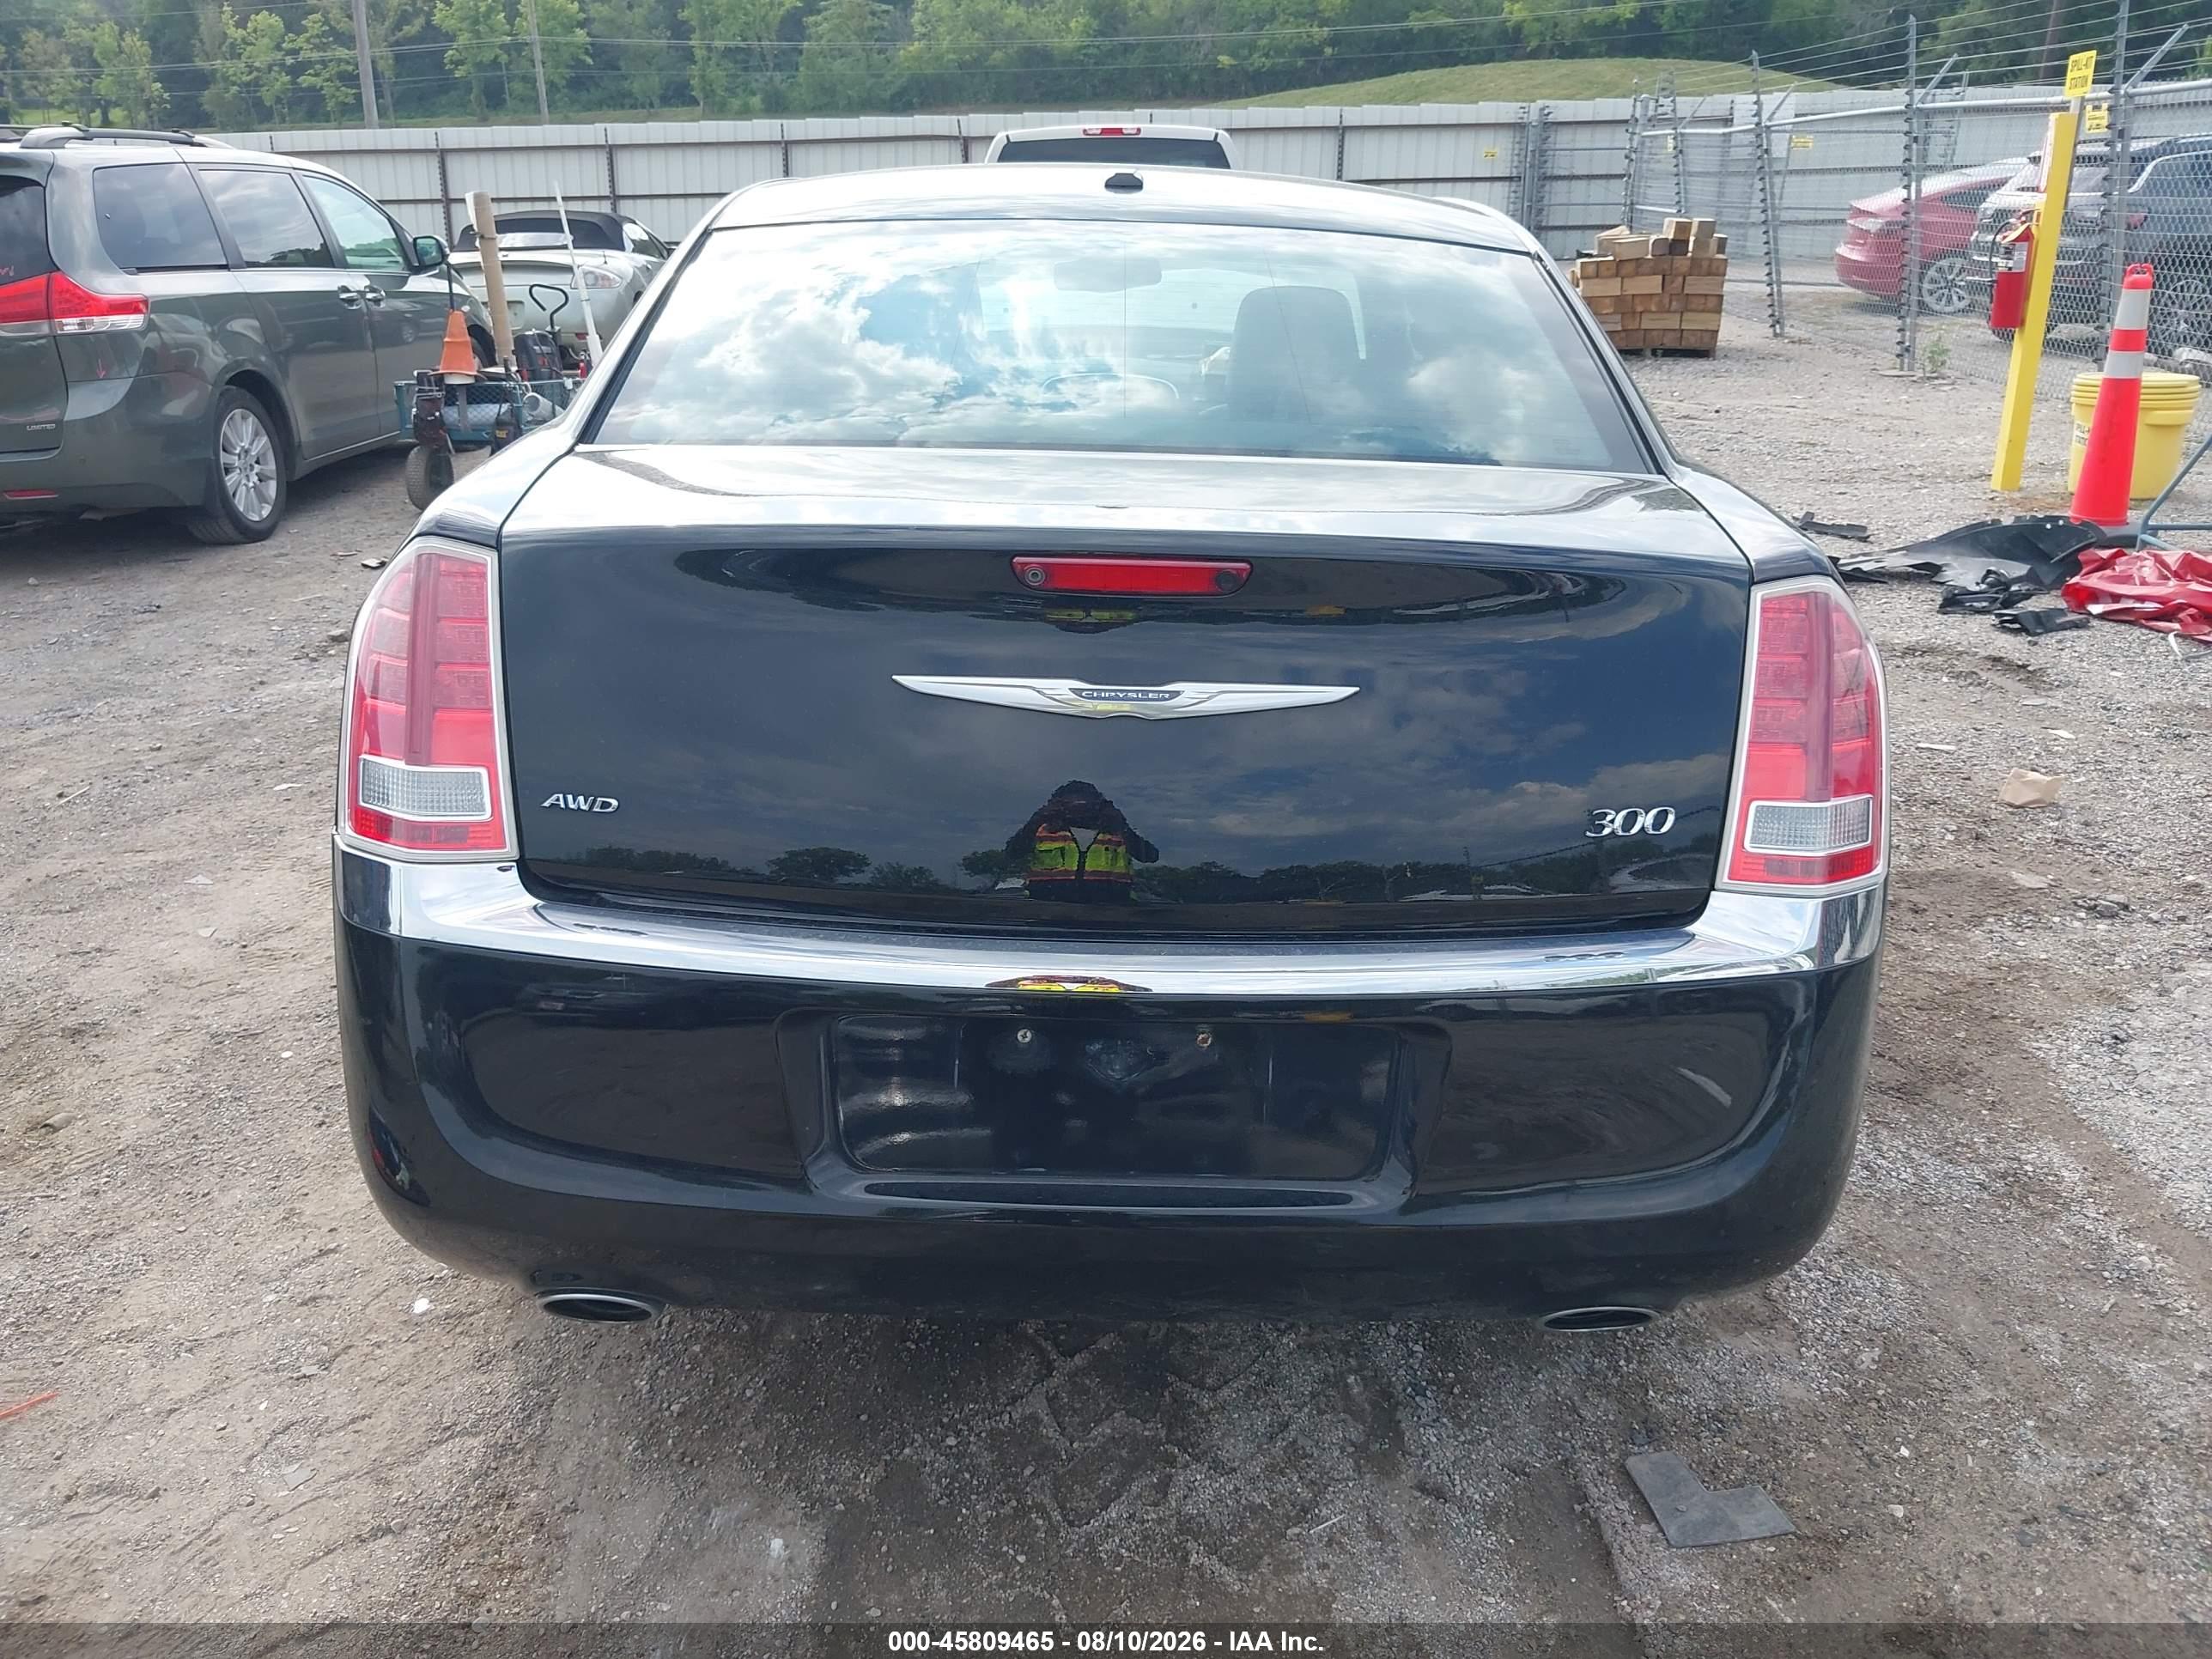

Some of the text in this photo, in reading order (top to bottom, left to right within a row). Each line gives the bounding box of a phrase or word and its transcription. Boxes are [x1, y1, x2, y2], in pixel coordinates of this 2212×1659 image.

[2068, 75, 2089, 90] STATION
[1081, 690, 1170, 700] CHRYSLER
[540, 793, 619, 813] AWD
[1584, 806, 1676, 837] 300
